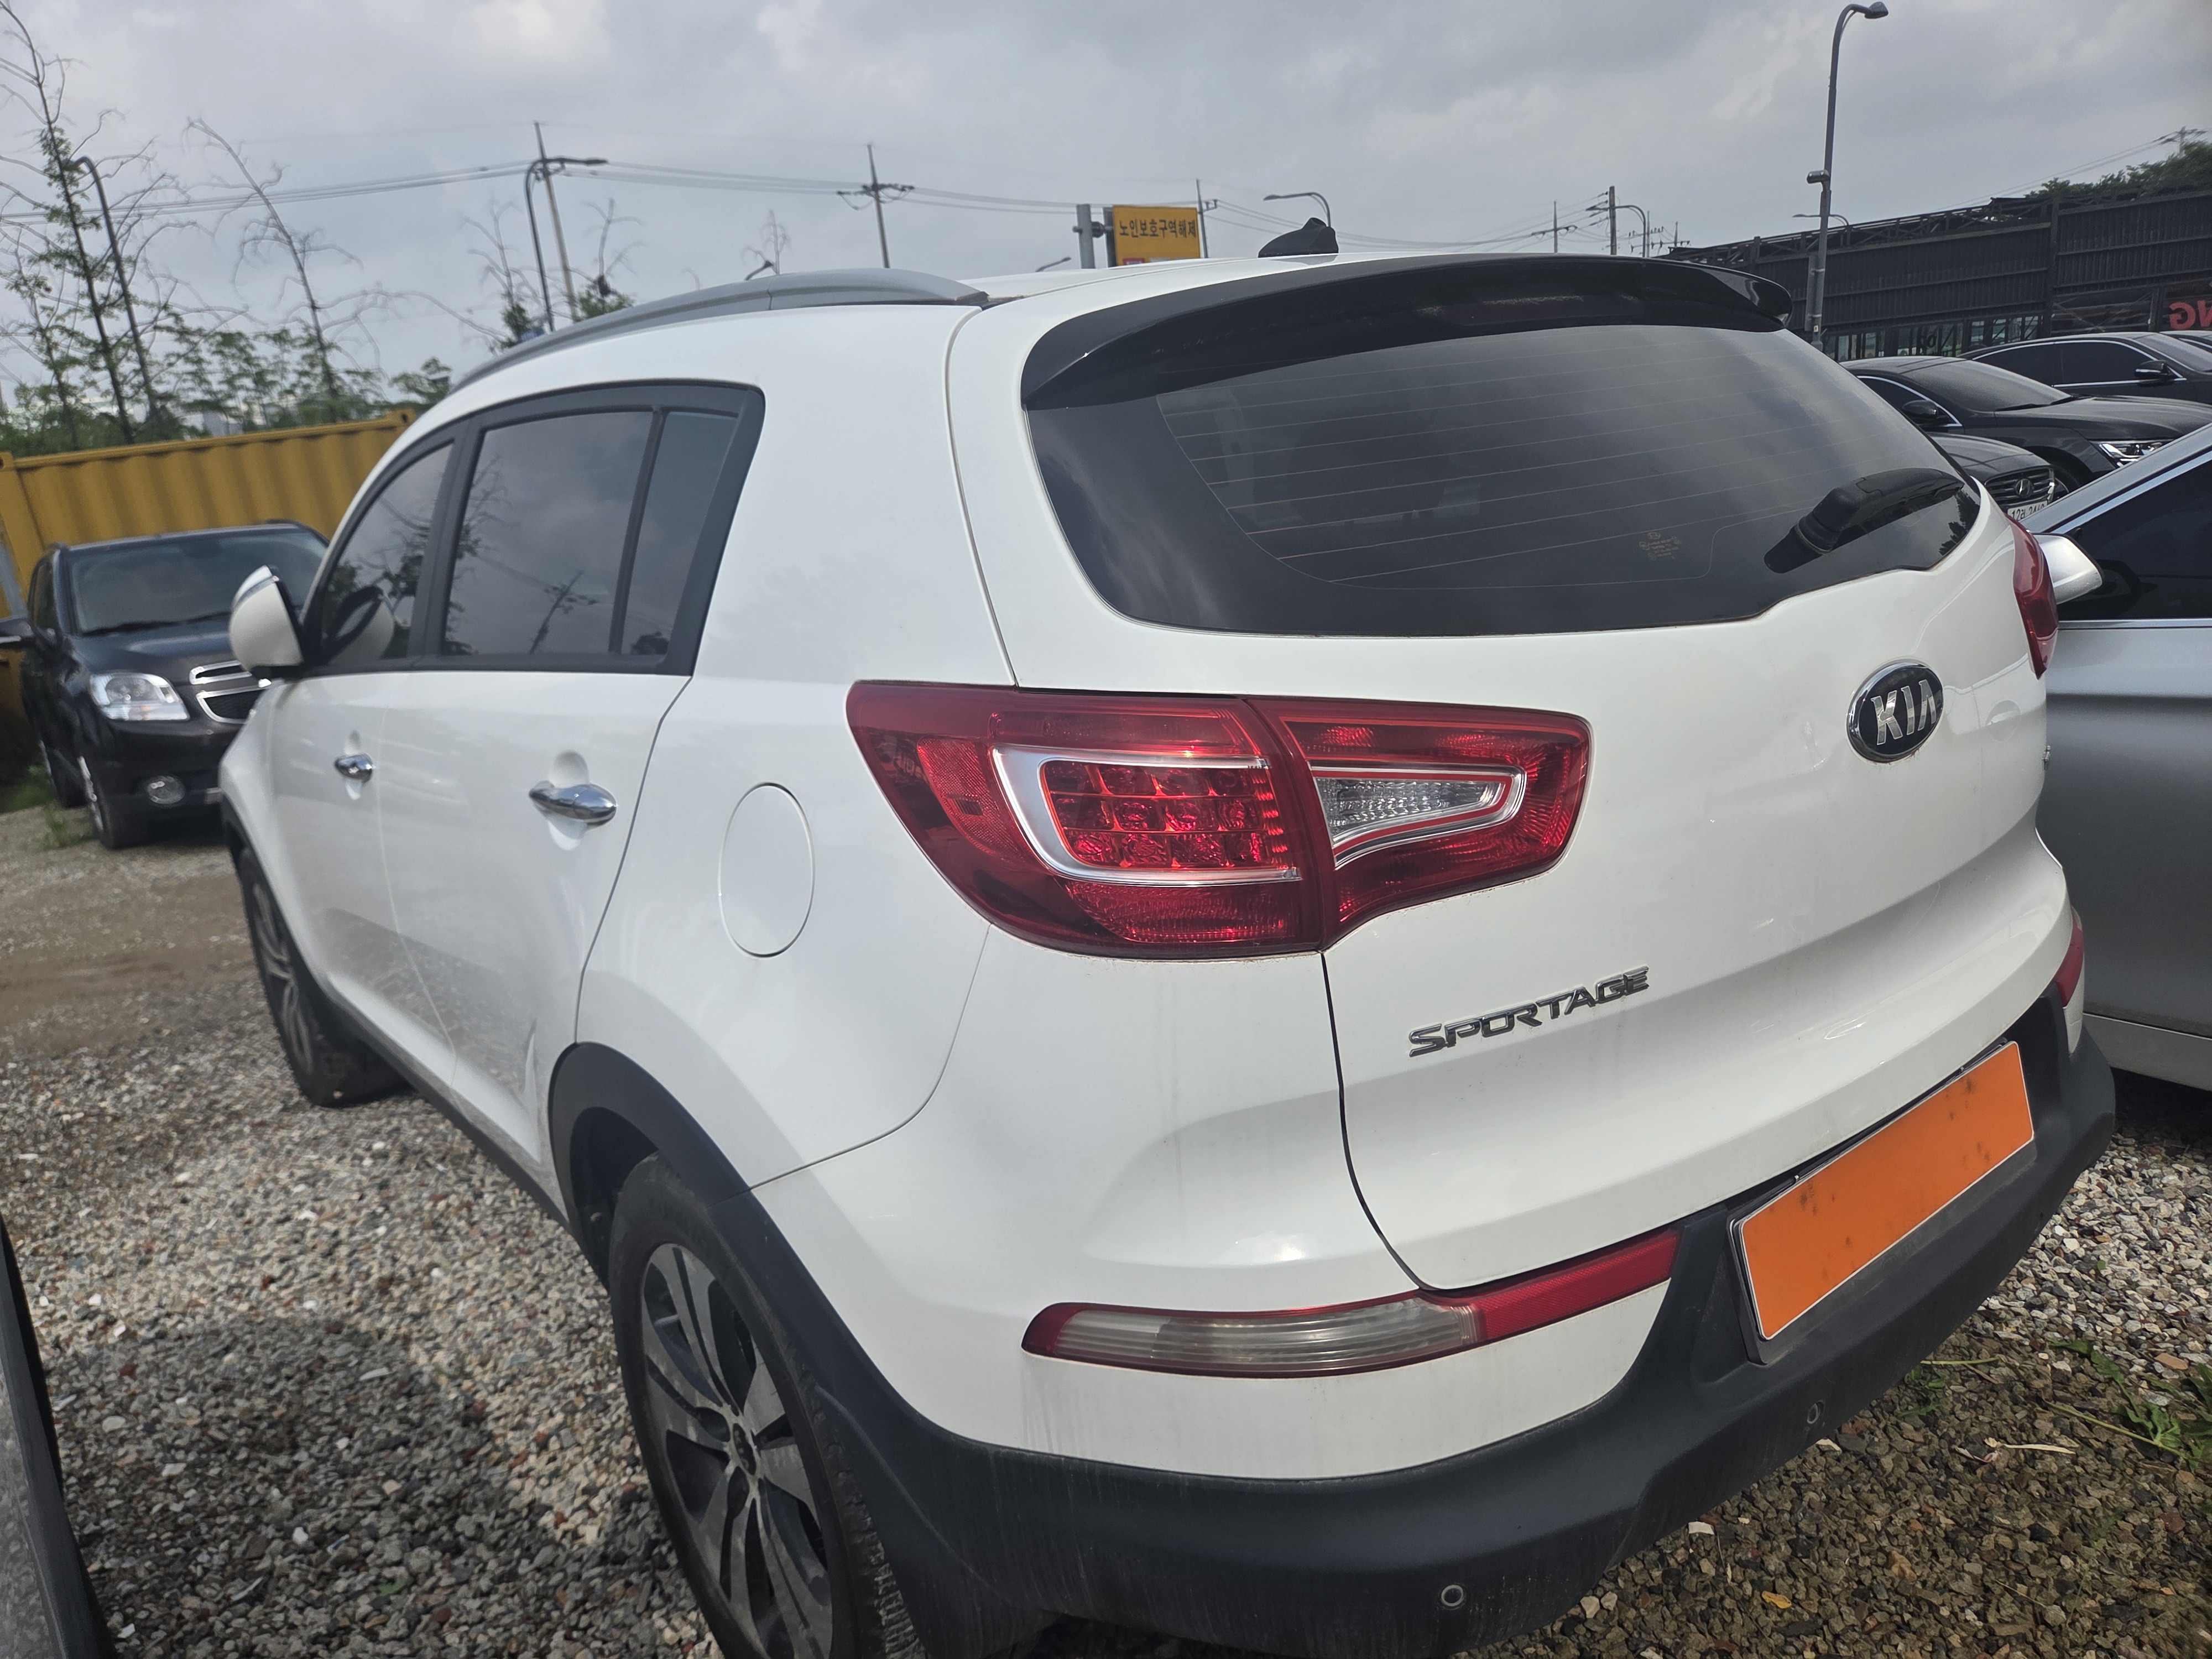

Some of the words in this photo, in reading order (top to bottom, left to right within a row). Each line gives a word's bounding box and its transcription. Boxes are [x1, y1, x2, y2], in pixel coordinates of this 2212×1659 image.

[1119, 218, 1196, 238] 노인보호구역해제
[1870, 679, 1937, 745] KIA
[1408, 965, 1650, 1057] SPORTAGE
